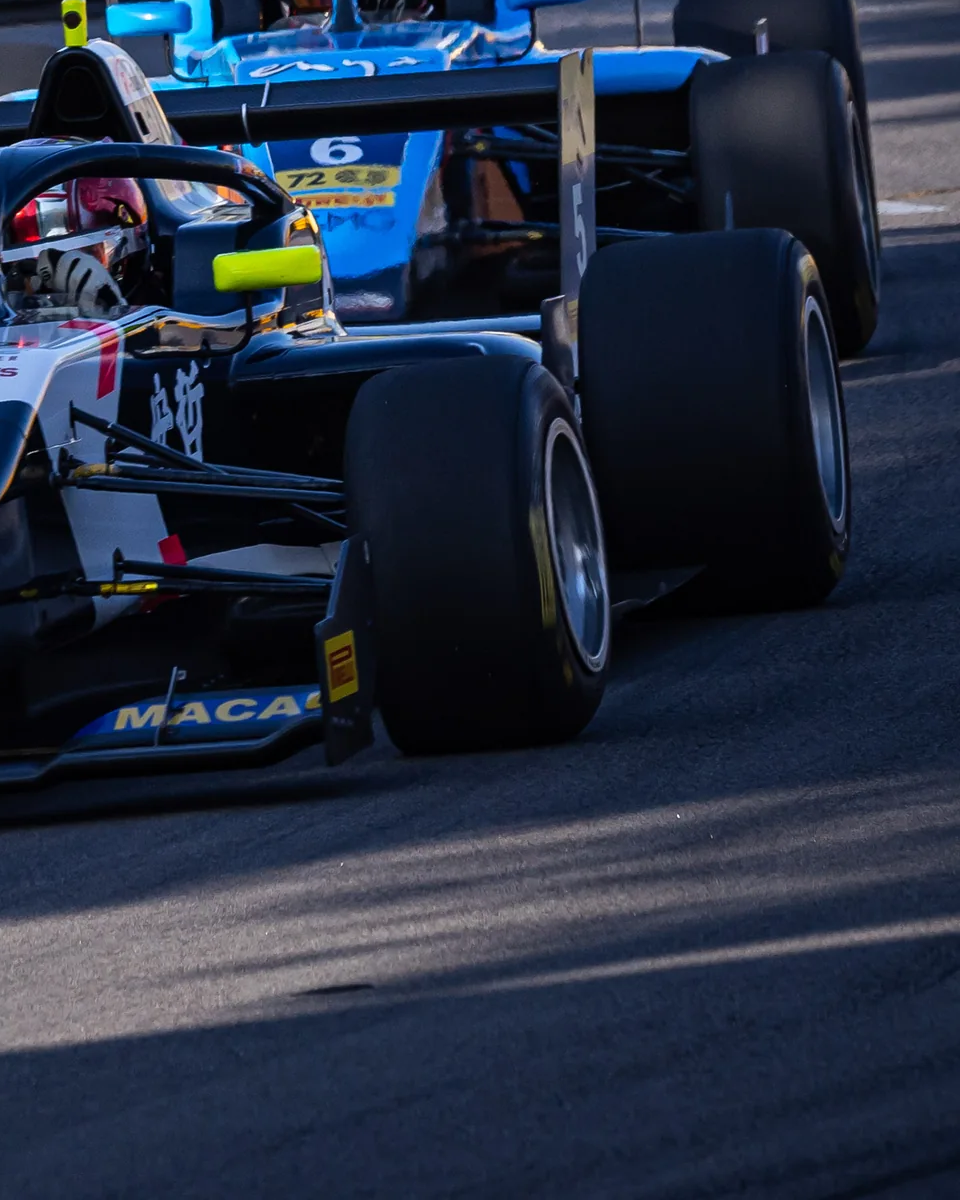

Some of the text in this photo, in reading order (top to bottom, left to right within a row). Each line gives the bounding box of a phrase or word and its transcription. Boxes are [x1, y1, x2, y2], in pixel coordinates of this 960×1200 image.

[310, 136, 364, 166] 6
[288, 172, 326, 188] 72
[571, 183, 587, 277] 5
